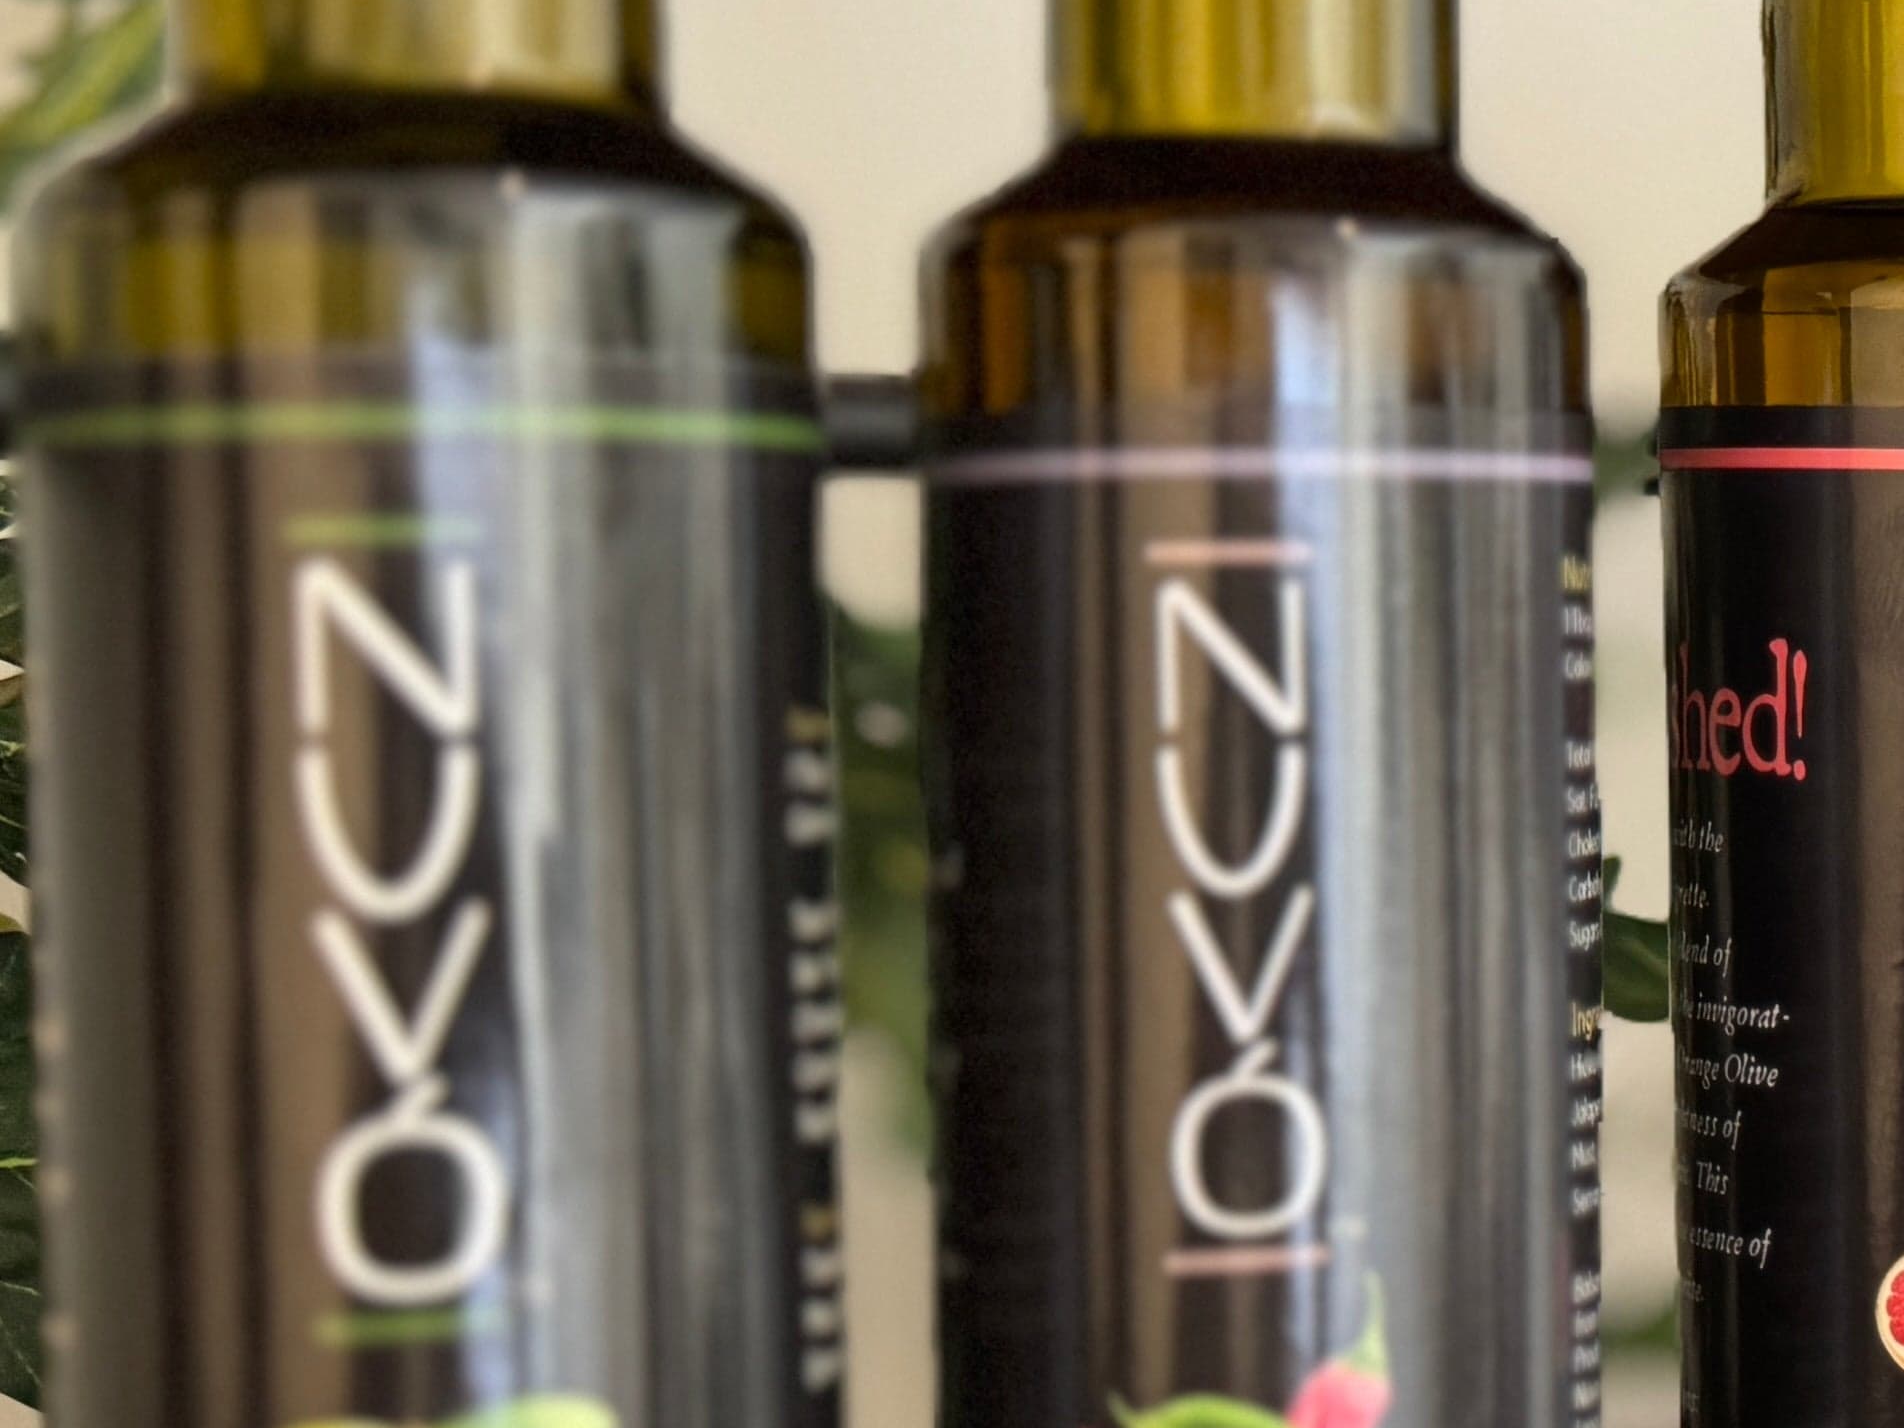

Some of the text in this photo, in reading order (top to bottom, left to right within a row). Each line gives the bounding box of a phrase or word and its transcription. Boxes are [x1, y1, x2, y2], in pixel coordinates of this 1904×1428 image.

[1713, 936, 1732, 978] of
[1697, 992, 1790, 1037] invigorat-
[1724, 1052, 1779, 1088] Olive
[1722, 1110, 1742, 1150] of
[1696, 1160, 1730, 1196] This
[1689, 1226, 1772, 1269] essence of
